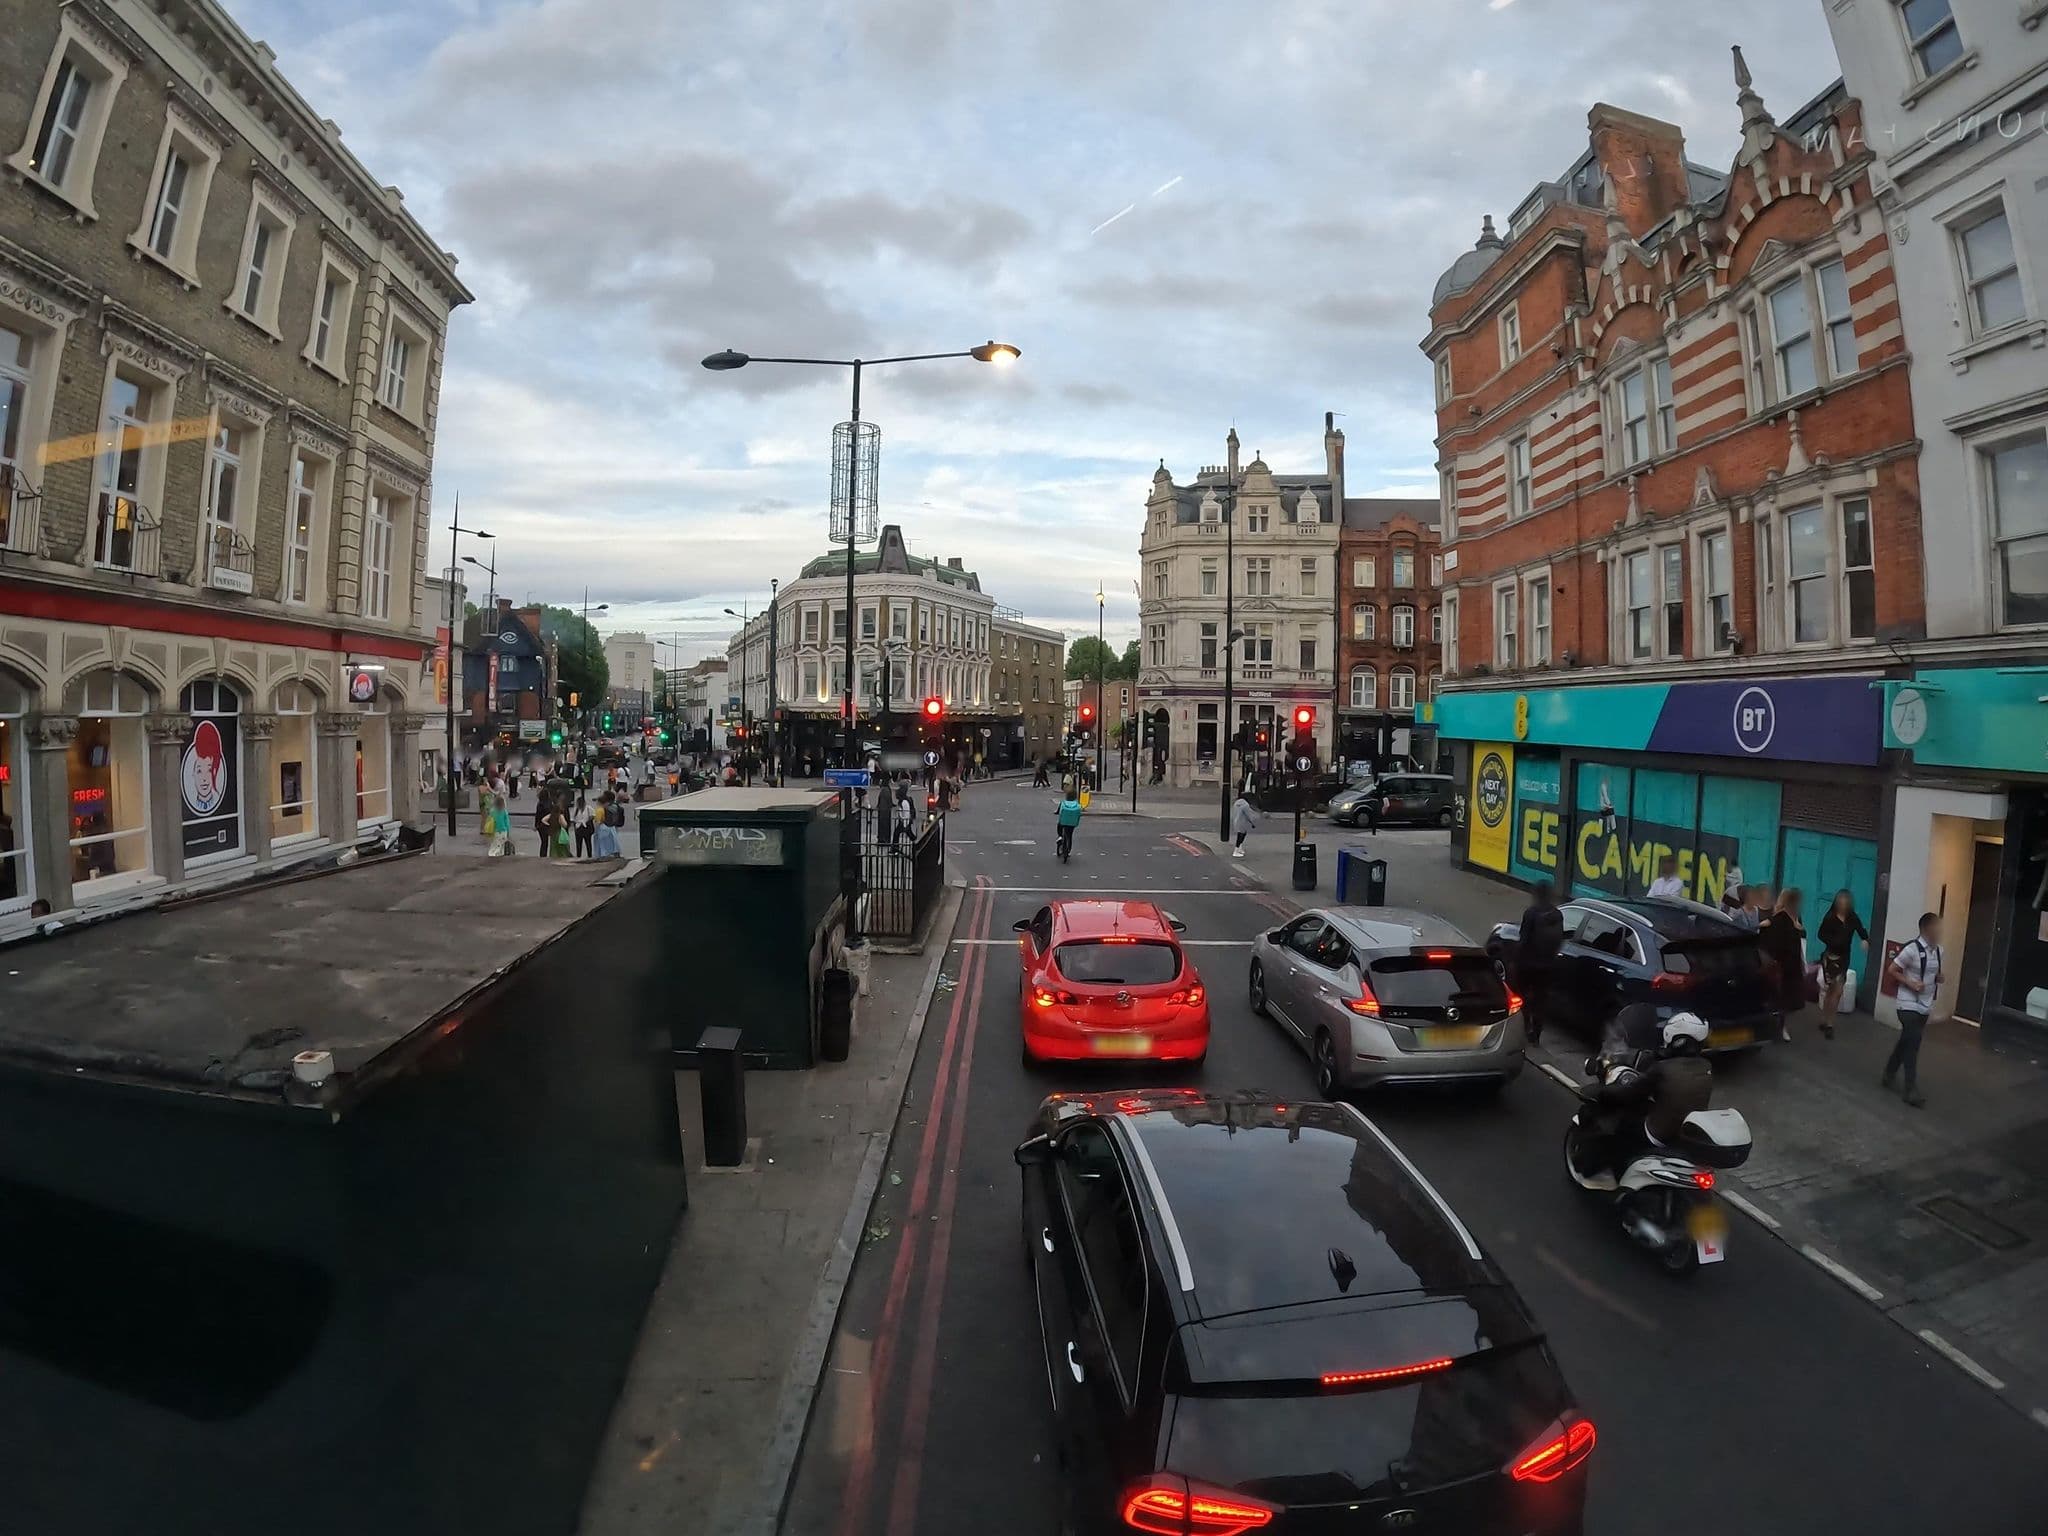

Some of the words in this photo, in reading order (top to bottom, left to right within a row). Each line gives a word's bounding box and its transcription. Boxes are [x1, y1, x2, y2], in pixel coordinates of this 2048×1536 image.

[1743, 708, 1766, 732] BT
[1485, 779, 1501, 791] NEXT
[1520, 779, 1549, 793] WELCOME
[1551, 783, 1560, 794] TO
[73, 788, 105, 802] FRESH
[1486, 793, 1498, 804] DAY
[1522, 807, 1560, 868] EE
